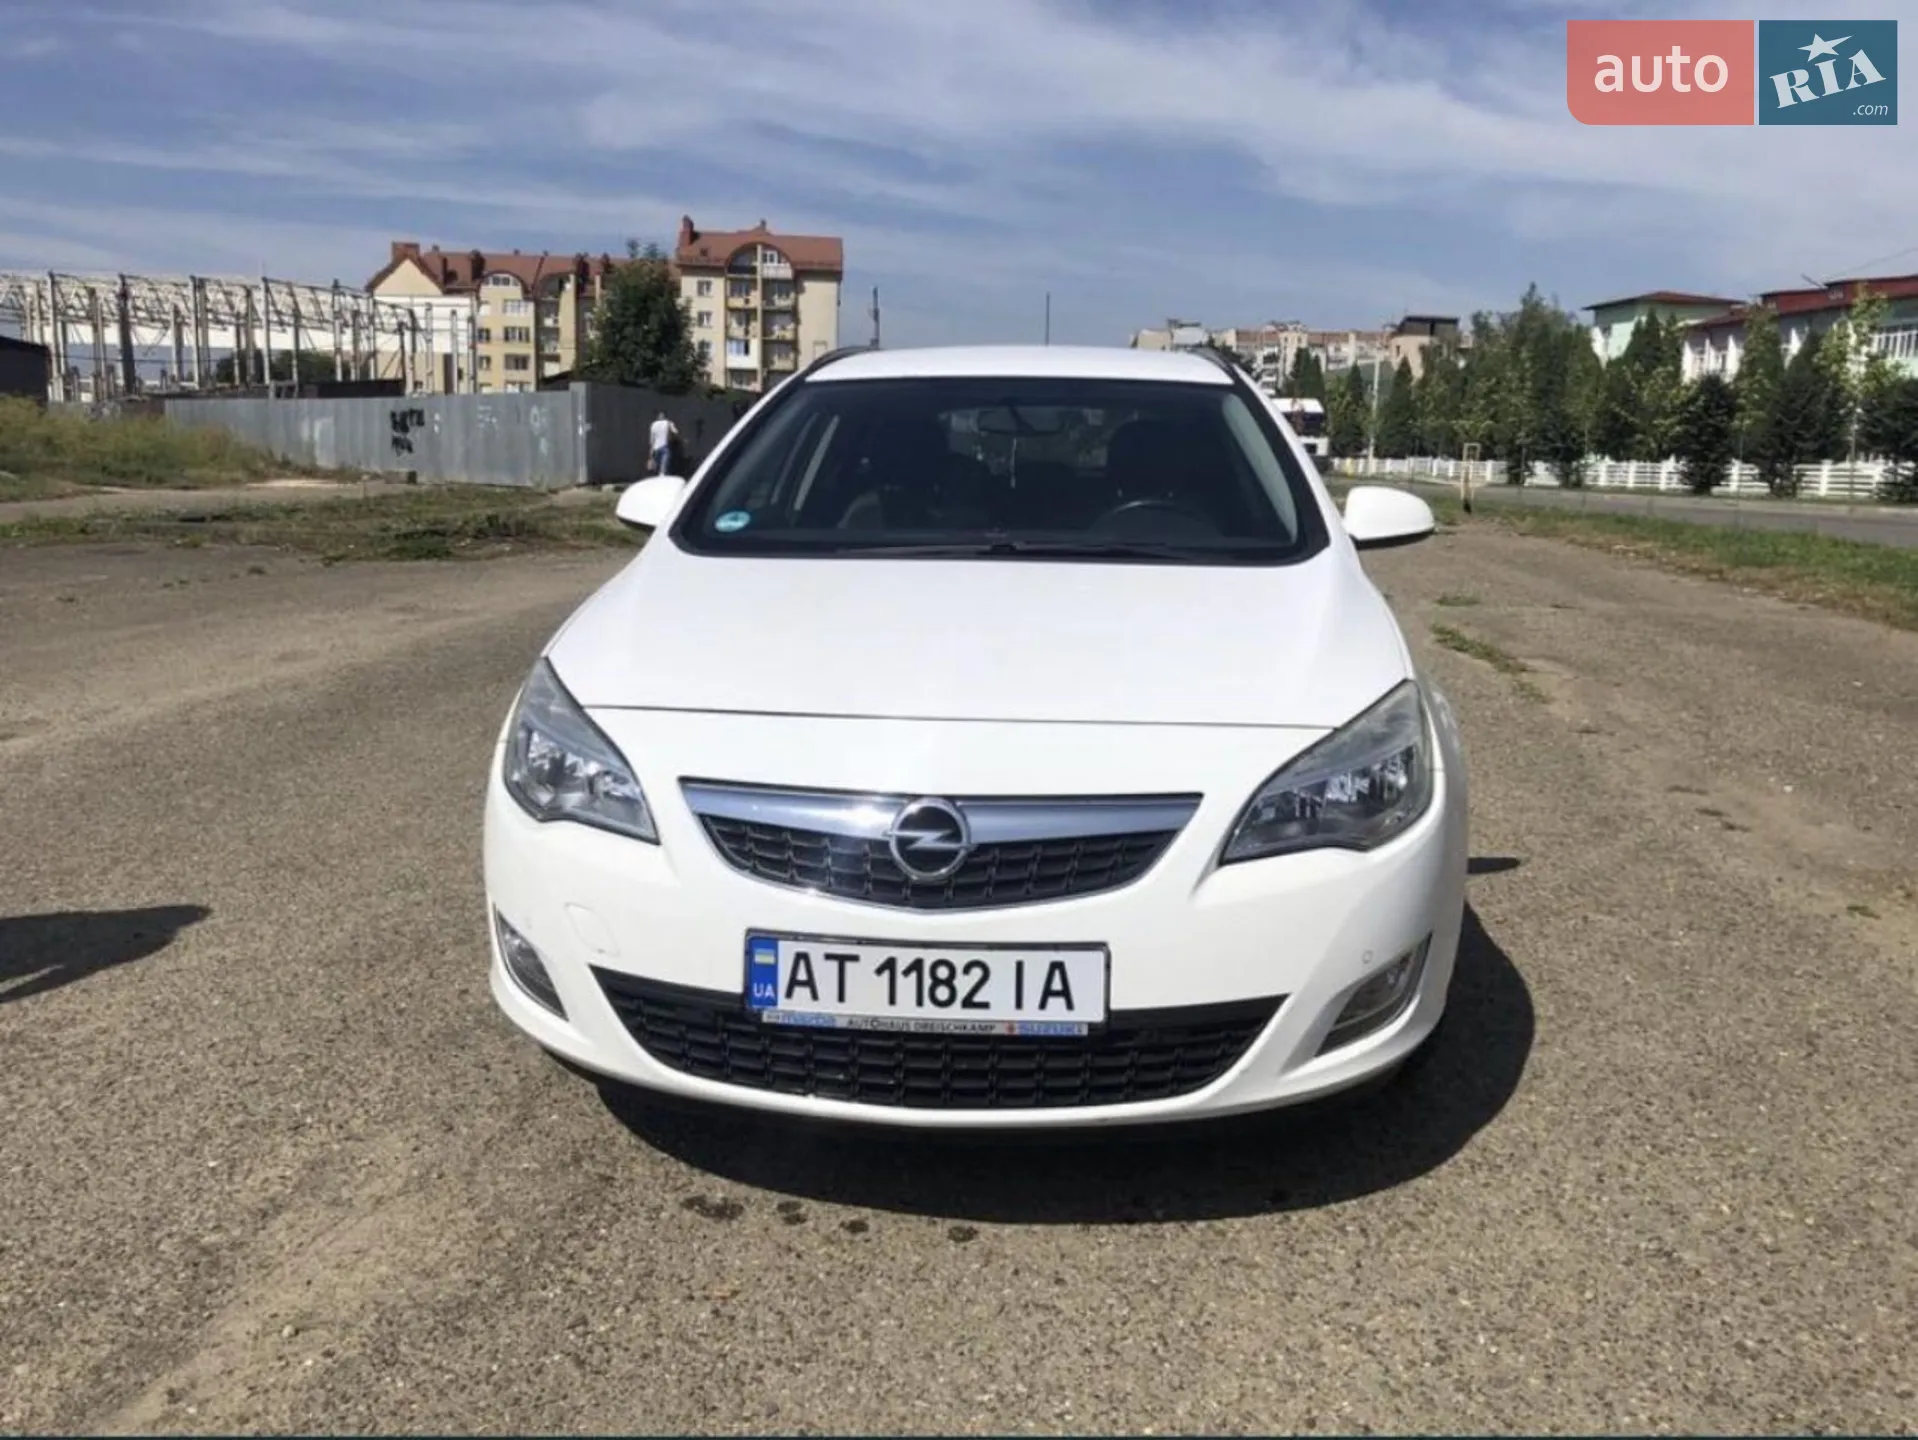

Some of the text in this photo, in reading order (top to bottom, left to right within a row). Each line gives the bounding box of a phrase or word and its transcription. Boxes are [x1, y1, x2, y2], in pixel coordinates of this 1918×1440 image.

[753, 982, 776, 998] UA
[784, 951, 1075, 1011] AT 1182 IA
